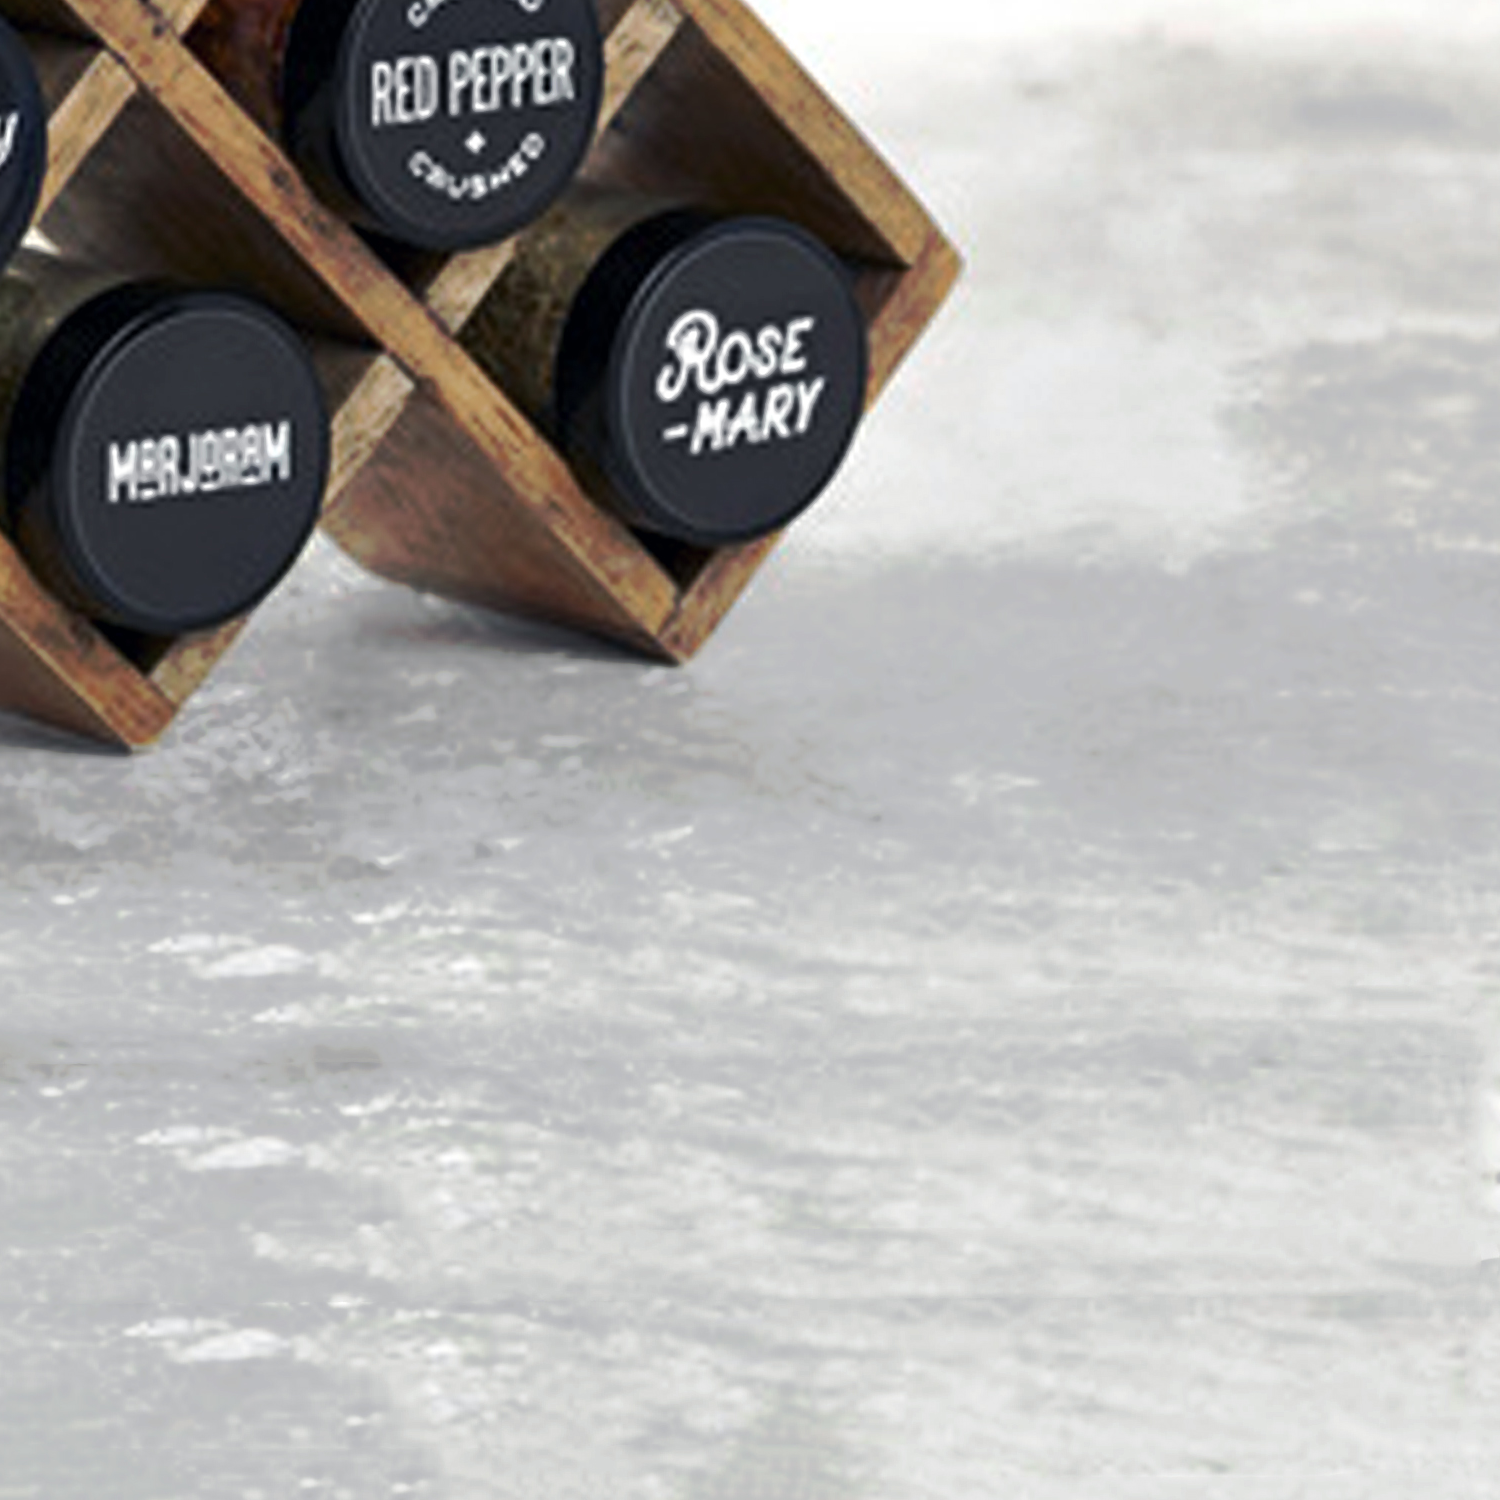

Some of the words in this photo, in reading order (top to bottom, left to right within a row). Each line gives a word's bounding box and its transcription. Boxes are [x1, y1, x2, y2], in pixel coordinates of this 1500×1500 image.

[370, 54, 440, 128] RED
[447, 37, 576, 117] PEPPER
[407, 131, 546, 200] CRUSHED
[654, 307, 816, 402] ROSE
[106, 420, 291, 503] MARJORAM
